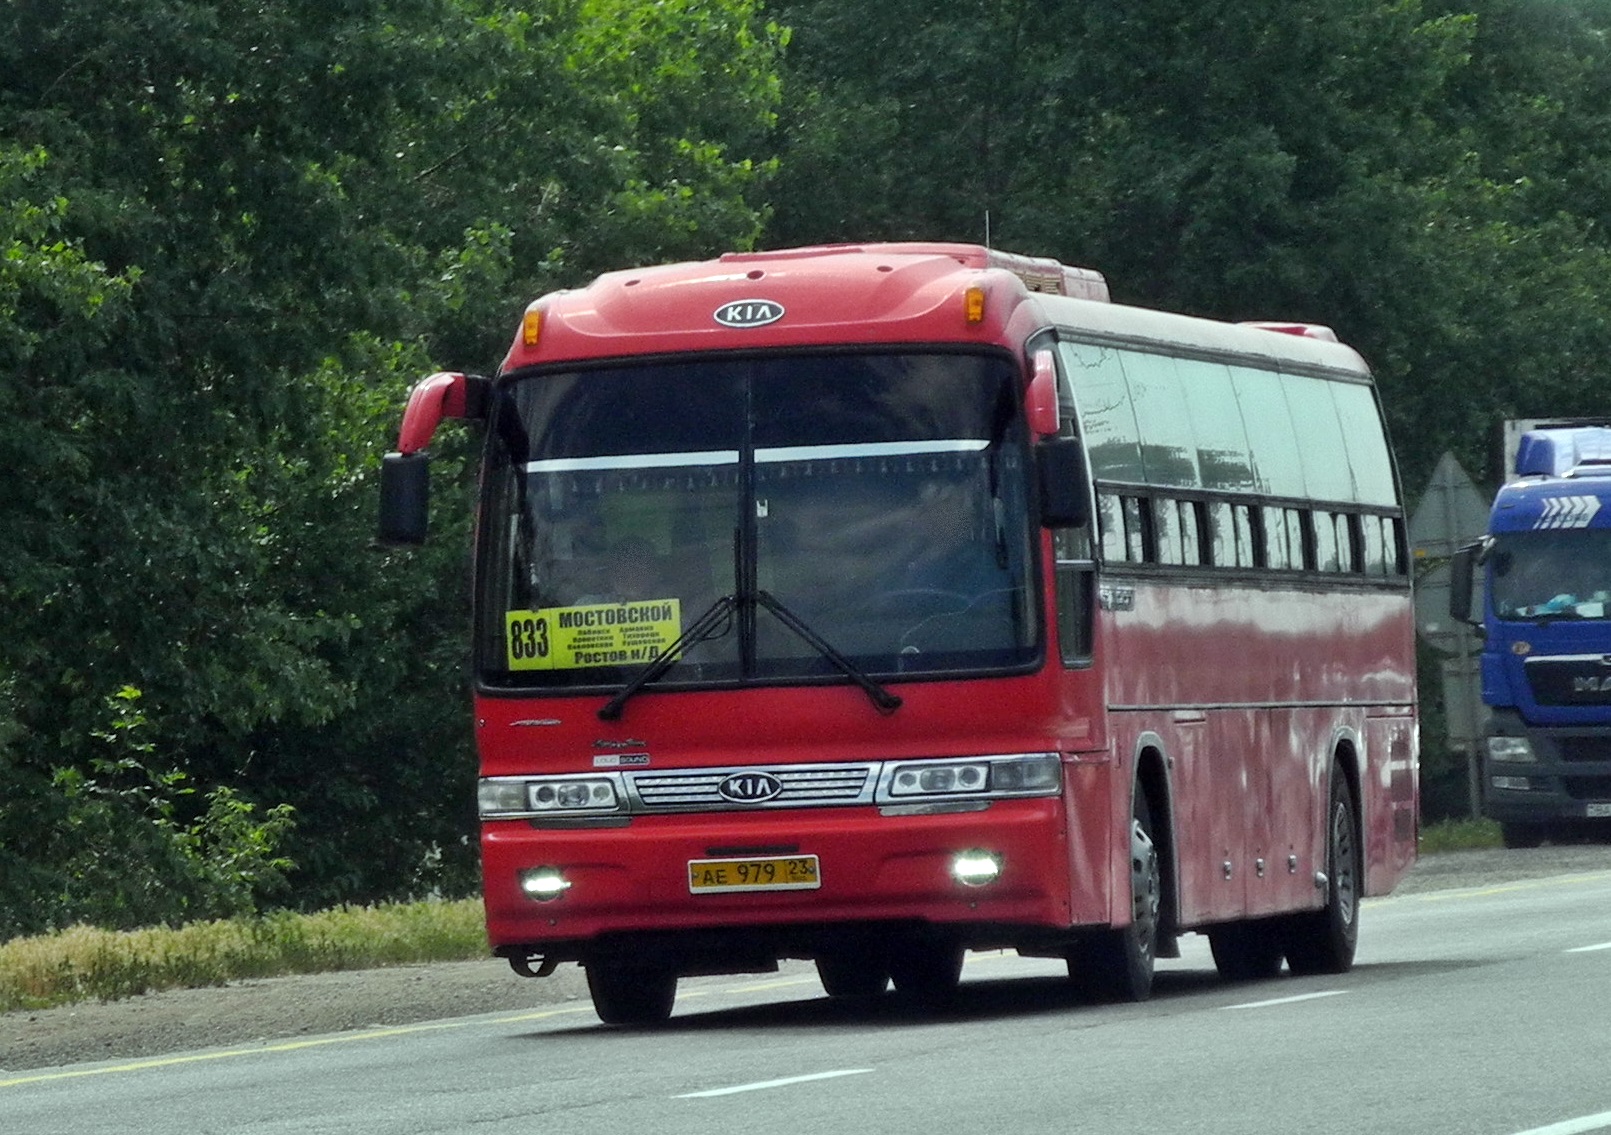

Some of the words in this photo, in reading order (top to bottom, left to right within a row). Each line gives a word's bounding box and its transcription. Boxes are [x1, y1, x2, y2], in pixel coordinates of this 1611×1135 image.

[726, 305, 772, 321] KIA
[558, 602, 673, 628] МОСТОВСКОЙ
[510, 618, 549, 660] 833
[574, 650, 627, 664] Ростов
[620, 755, 648, 764] SOUND
[728, 777, 772, 796] KIA
[703, 869, 728, 884] AE
[736, 863, 776, 883] 979
[788, 860, 808, 875] 23
